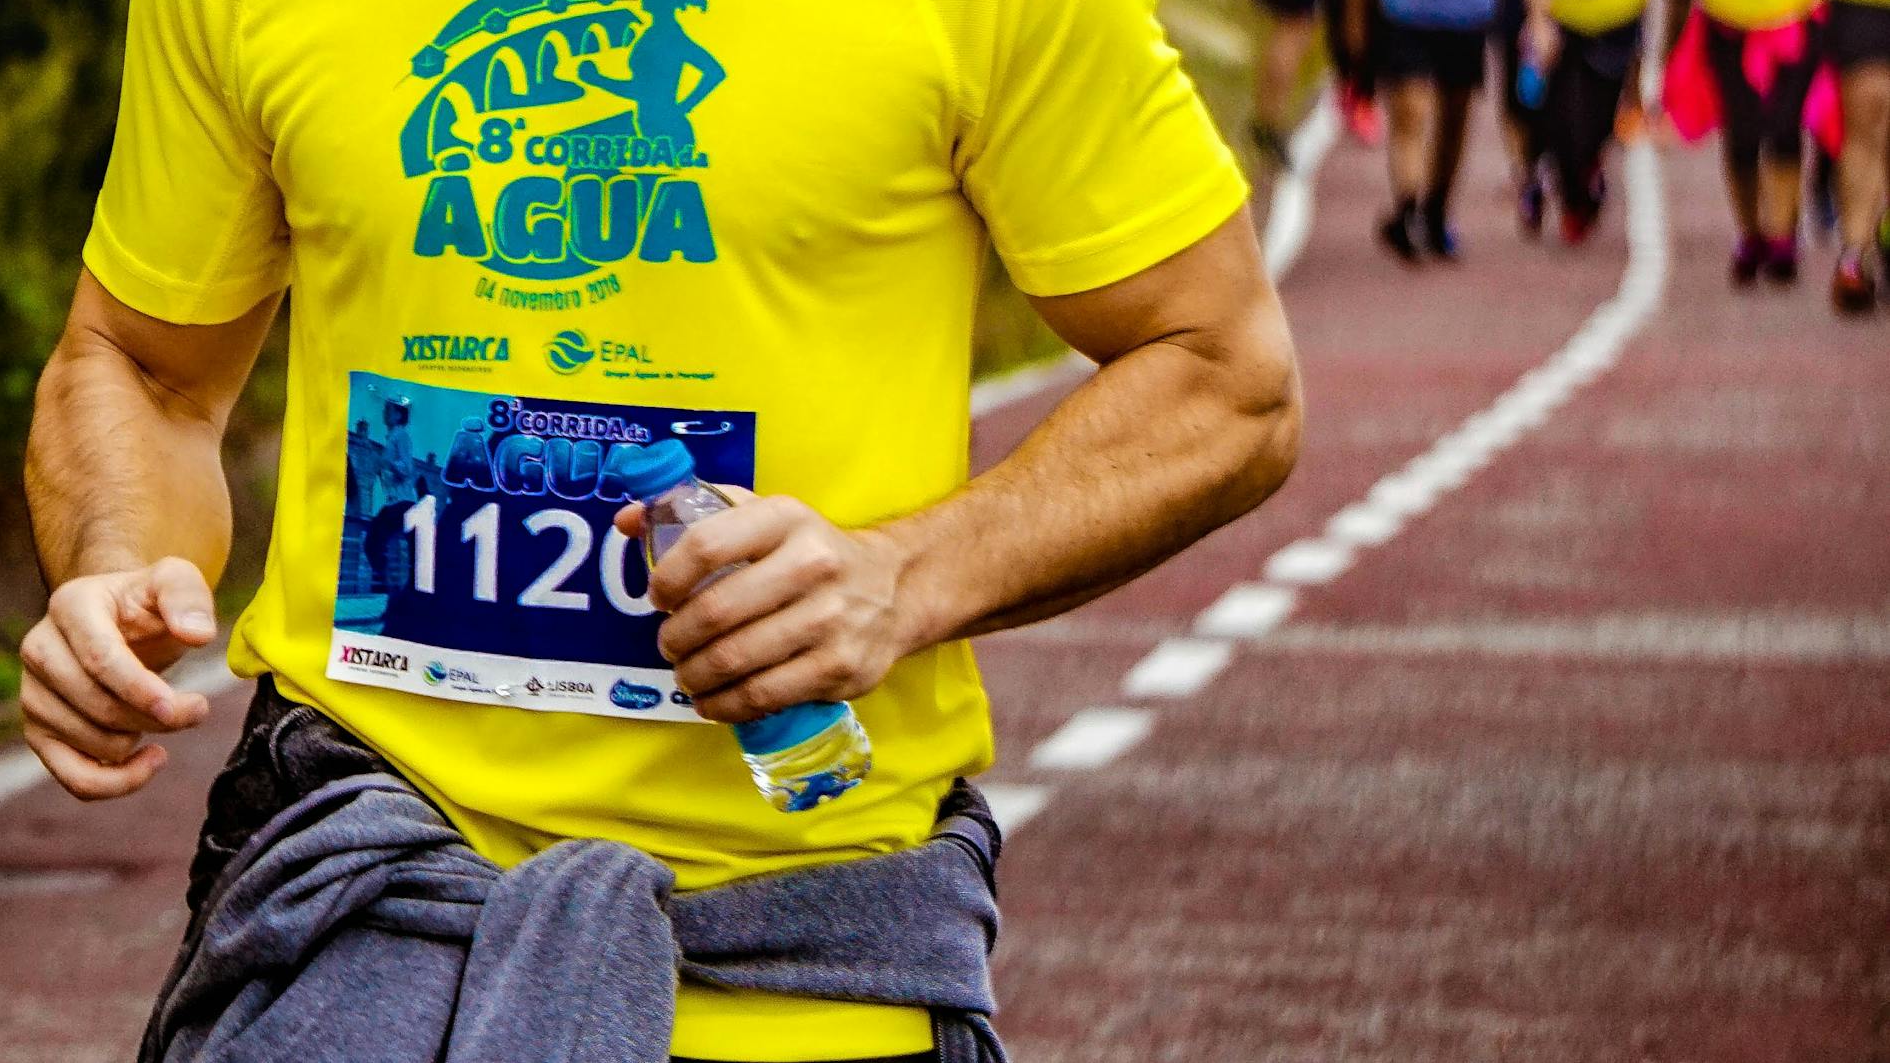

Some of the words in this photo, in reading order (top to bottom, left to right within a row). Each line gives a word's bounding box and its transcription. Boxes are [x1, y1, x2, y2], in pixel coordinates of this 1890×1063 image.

[525, 135, 676, 169] CORRIDA
[677, 142, 710, 169] da
[413, 150, 718, 264] ÁGUA
[475, 277, 497, 301] 04
[500, 287, 582, 311] novembro
[586, 273, 622, 304] 2018
[401, 334, 510, 362] XISTARCA
[601, 340, 654, 364] EPAL
[515, 411, 626, 440] CORRIDA
[624, 422, 651, 443] da
[340, 645, 409, 673] XISTARCA
[448, 667, 480, 684] EPAL
[547, 680, 595, 695] LISBOA
